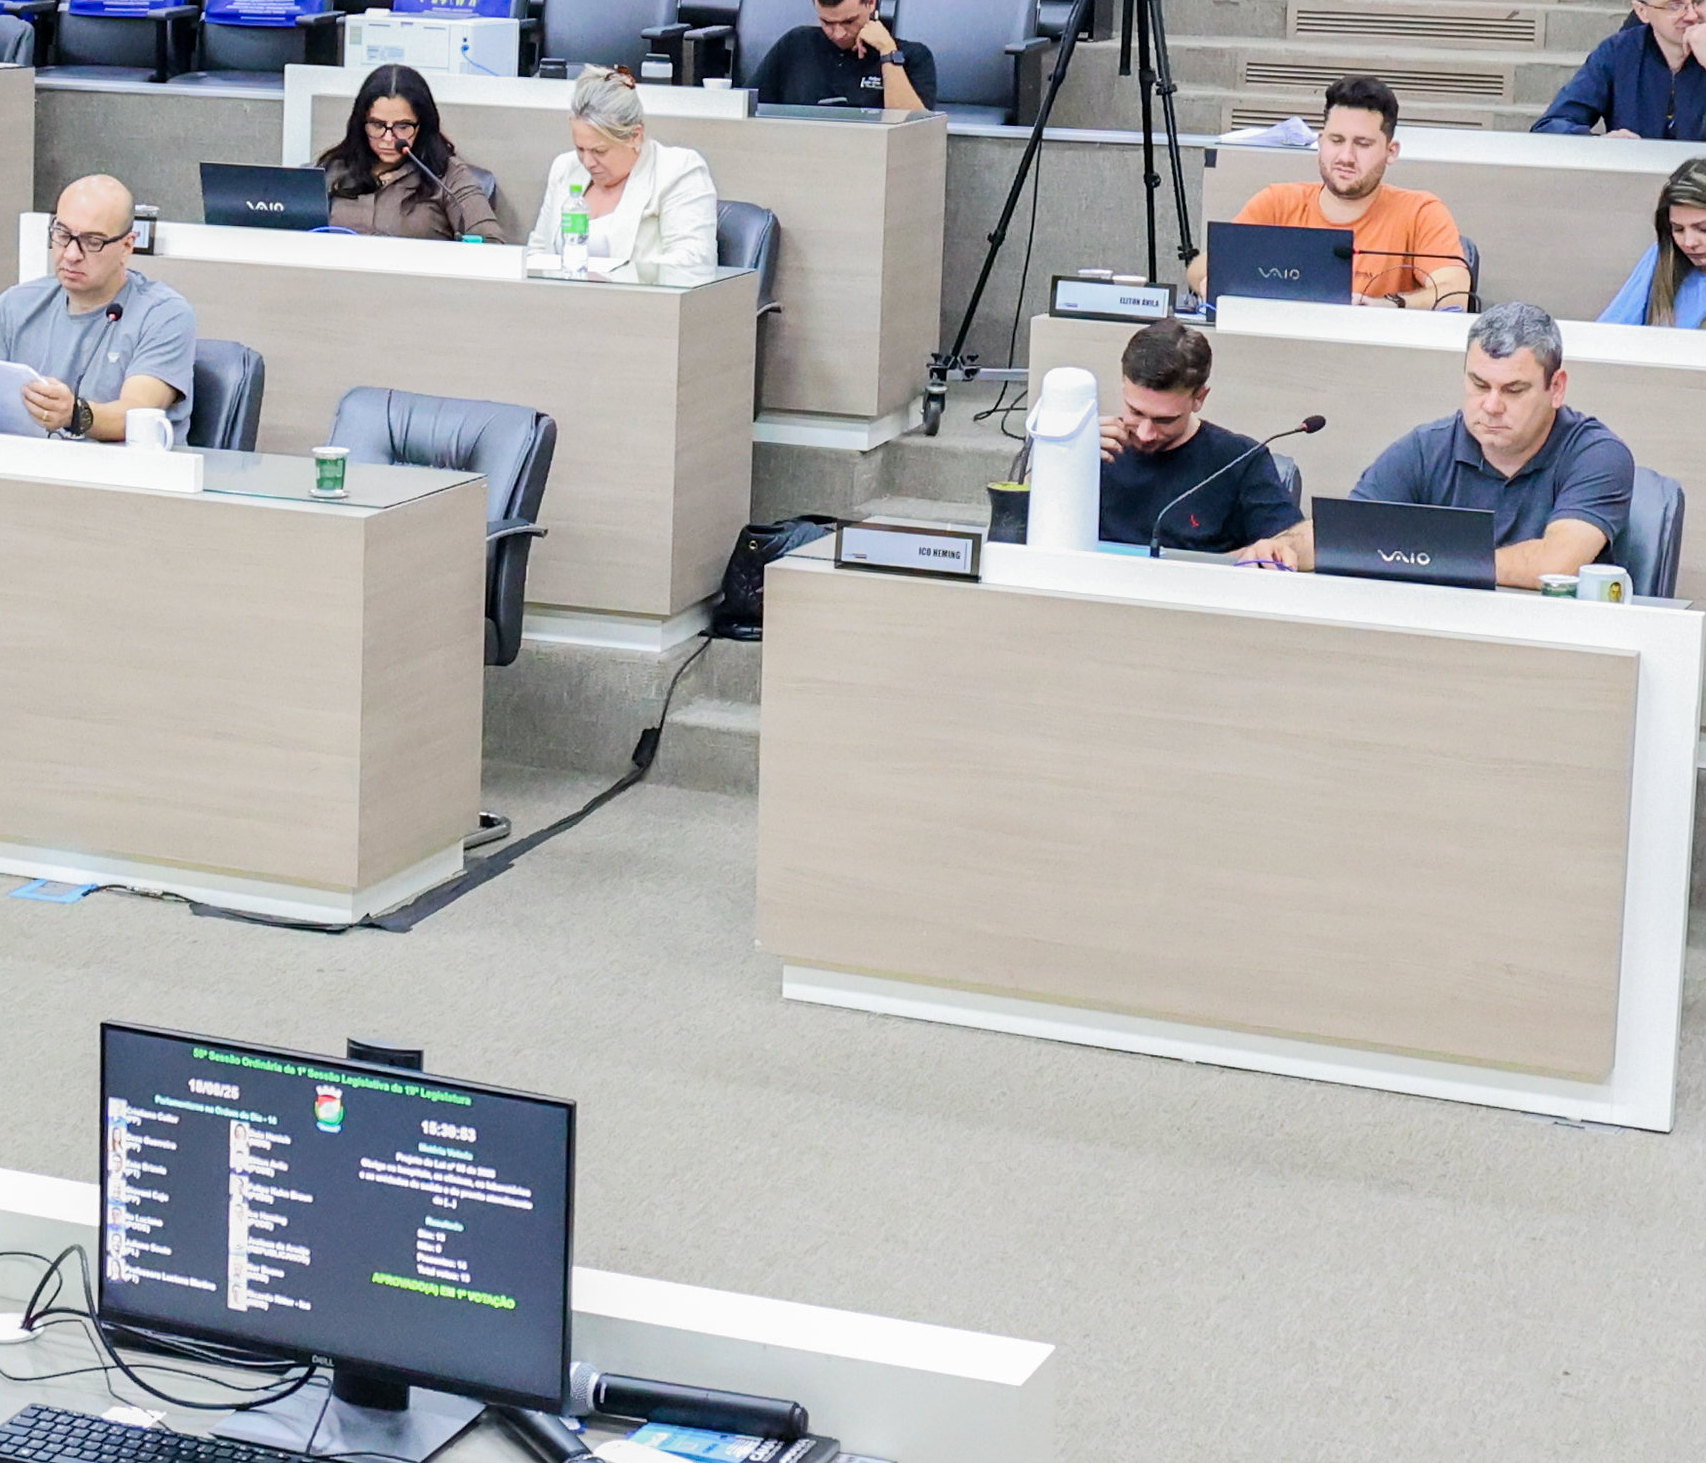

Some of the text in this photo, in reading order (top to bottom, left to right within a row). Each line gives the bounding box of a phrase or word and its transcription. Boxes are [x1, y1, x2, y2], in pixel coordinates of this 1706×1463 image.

[1258, 267, 1301, 280] VAIO
[918, 547, 961, 559] ICO HEMING
[1377, 549, 1431, 565] VAIO
[312, 1354, 335, 1367] DELL
